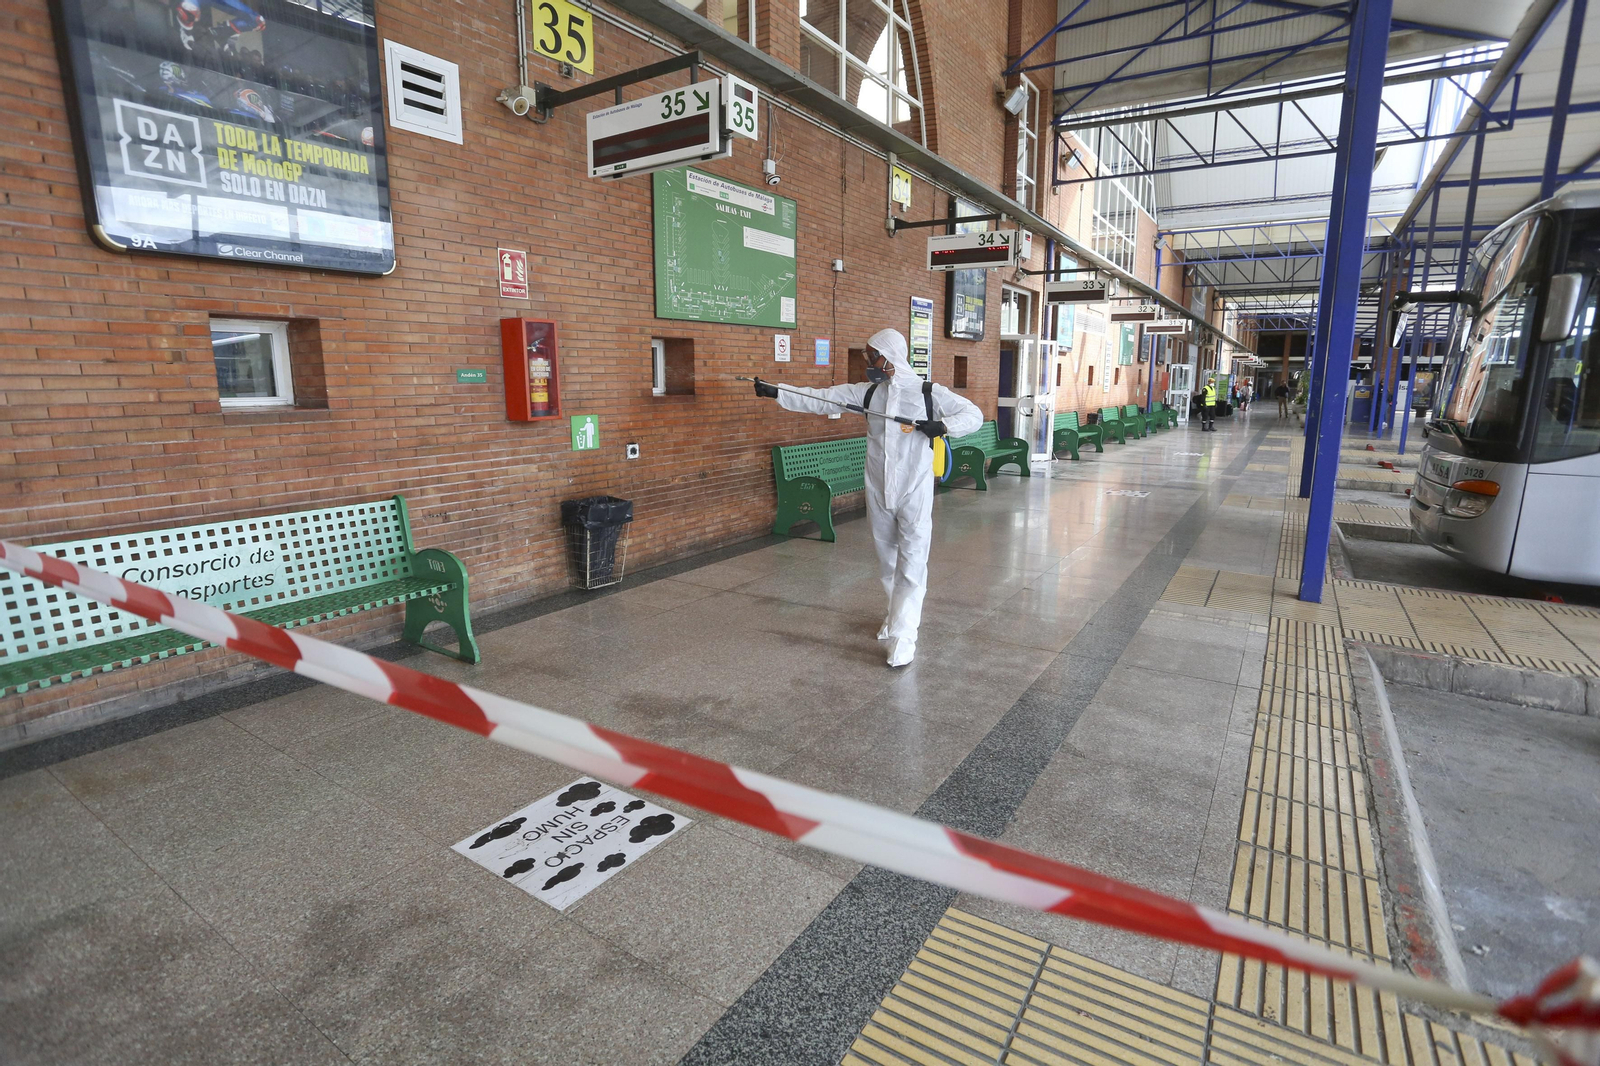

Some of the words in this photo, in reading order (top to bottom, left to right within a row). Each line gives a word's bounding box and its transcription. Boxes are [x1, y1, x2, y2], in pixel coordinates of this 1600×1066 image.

[538, 2, 587, 64] 35
[661, 91, 686, 119] 35
[732, 101, 755, 133] 35
[213, 122, 259, 152] TODA
[262, 133, 282, 157] LA
[284, 138, 369, 175] TEMPORADA
[217, 147, 239, 170] DE
[242, 153, 303, 182] MotoGP
[220, 171, 262, 198] SOLO
[266, 182, 286, 202] EN
[288, 186, 327, 208] DAZN
[688, 172, 712, 184] Estación
[720, 182, 748, 196] Autobuses
[894, 173, 909, 201] 34
[131, 233, 157, 250] 9A
[978, 233, 995, 246] 34
[234, 246, 262, 258] Clear
[263, 250, 304, 262] Channel
[502, 286, 526, 294] EXTINTOR
[1082, 281, 1095, 290] 33
[1137, 305, 1147, 313] 32
[819, 456, 843, 465] Consorcio
[843, 453, 850, 461] de
[822, 464, 851, 476] Transportes
[1431, 463, 1450, 480] ALSA
[1464, 466, 1484, 478] 3128
[121, 553, 241, 585] Consorcio
[249, 547, 275, 565] de
[176, 573, 275, 602] nsportes
[522, 806, 585, 842] HUMO
[551, 820, 589, 844] SIN
[544, 814, 631, 867] ESPACIO
